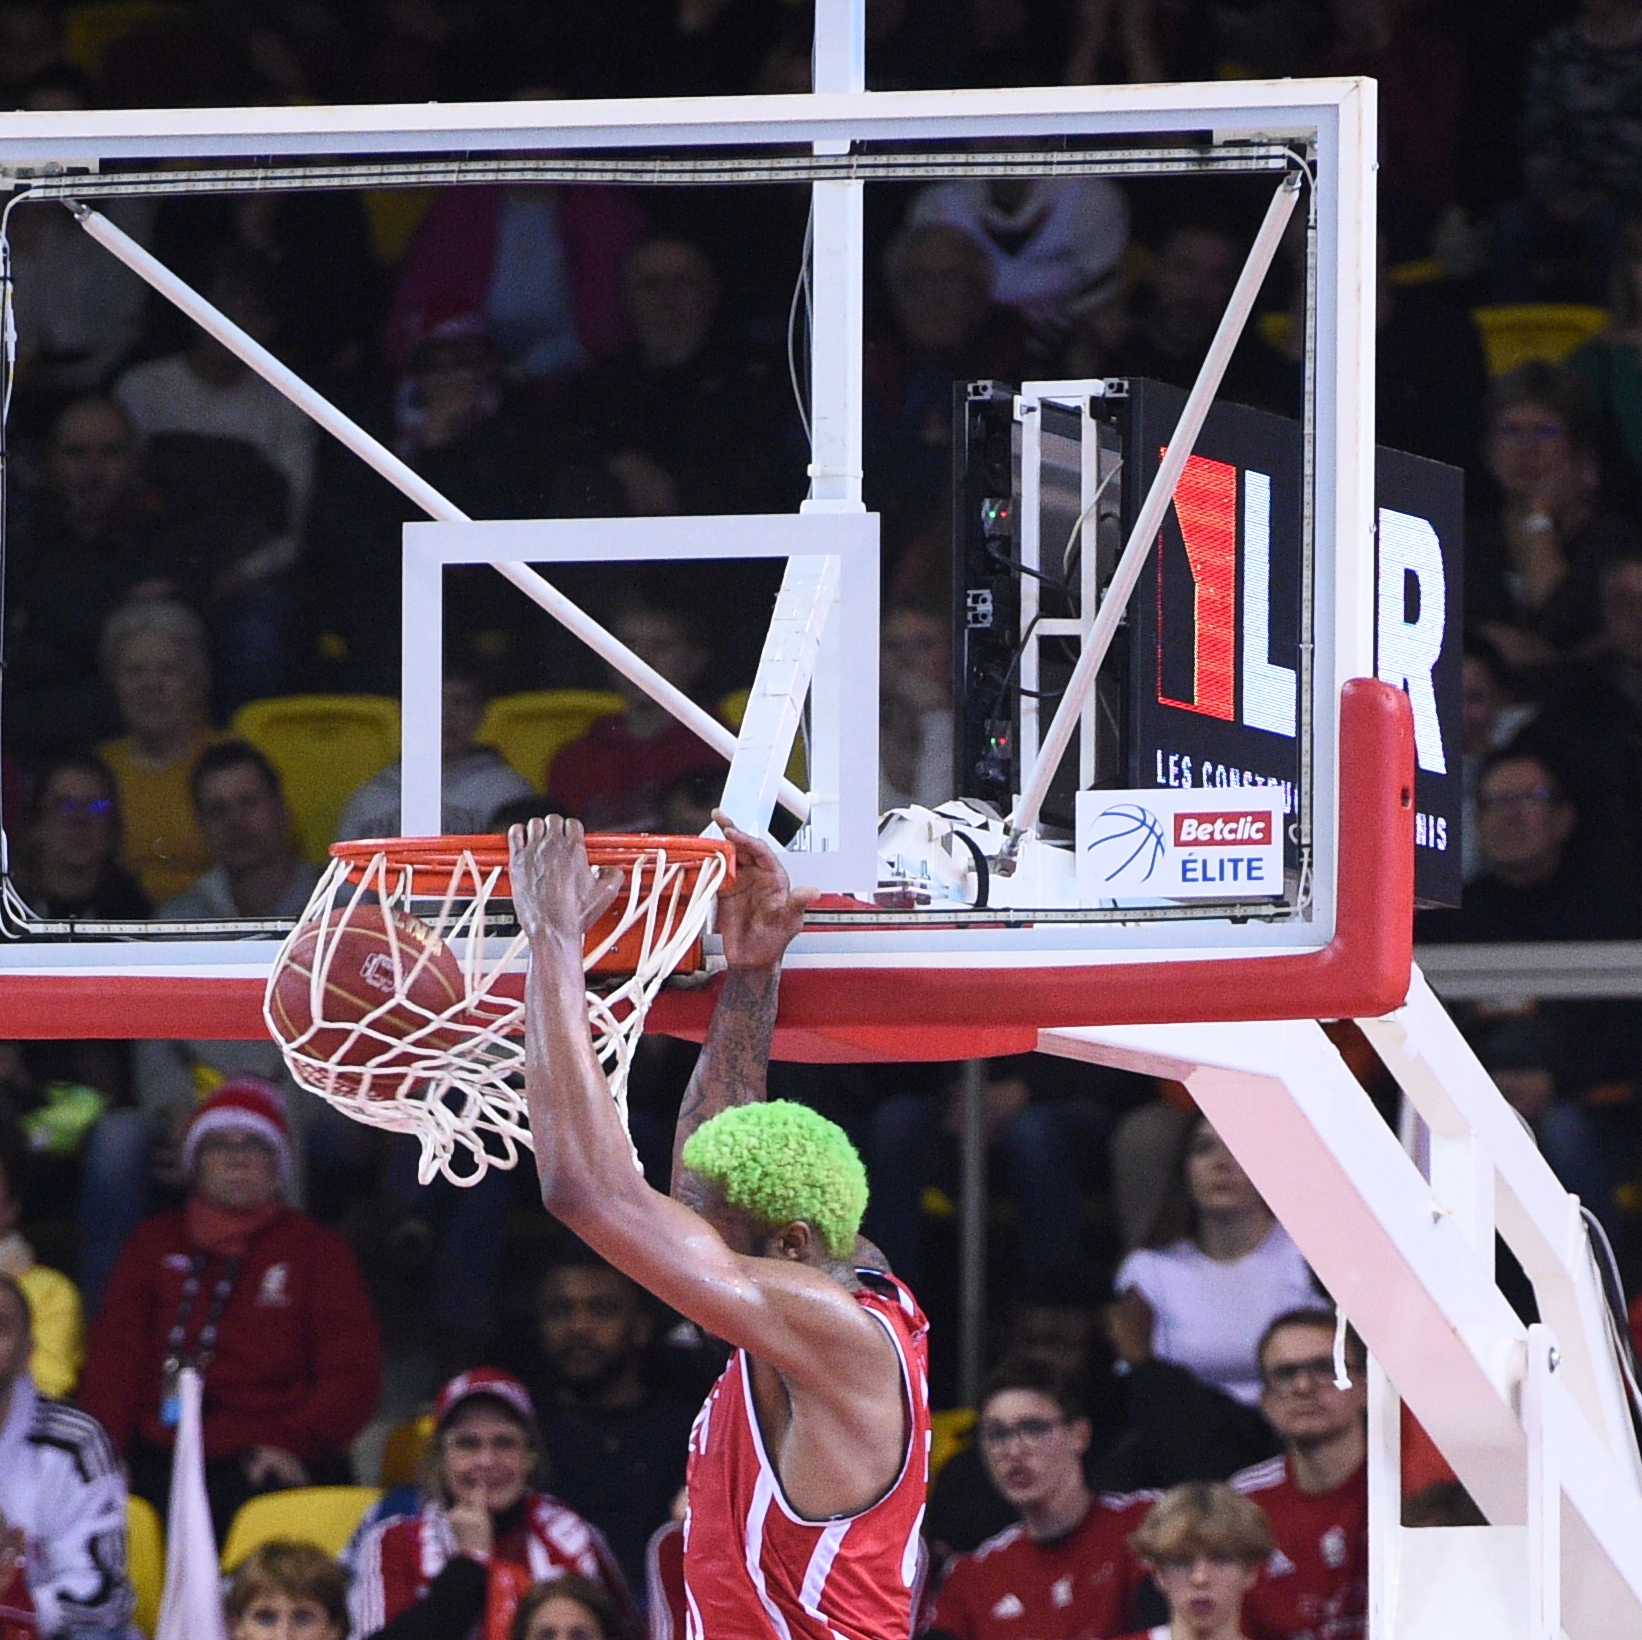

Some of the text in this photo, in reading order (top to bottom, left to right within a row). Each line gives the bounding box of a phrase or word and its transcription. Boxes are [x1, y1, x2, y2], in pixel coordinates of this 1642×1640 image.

[1156, 749, 1192, 789] LES
[1179, 817, 1266, 843] Betclic
[1180, 852, 1265, 883] ÉLITE
